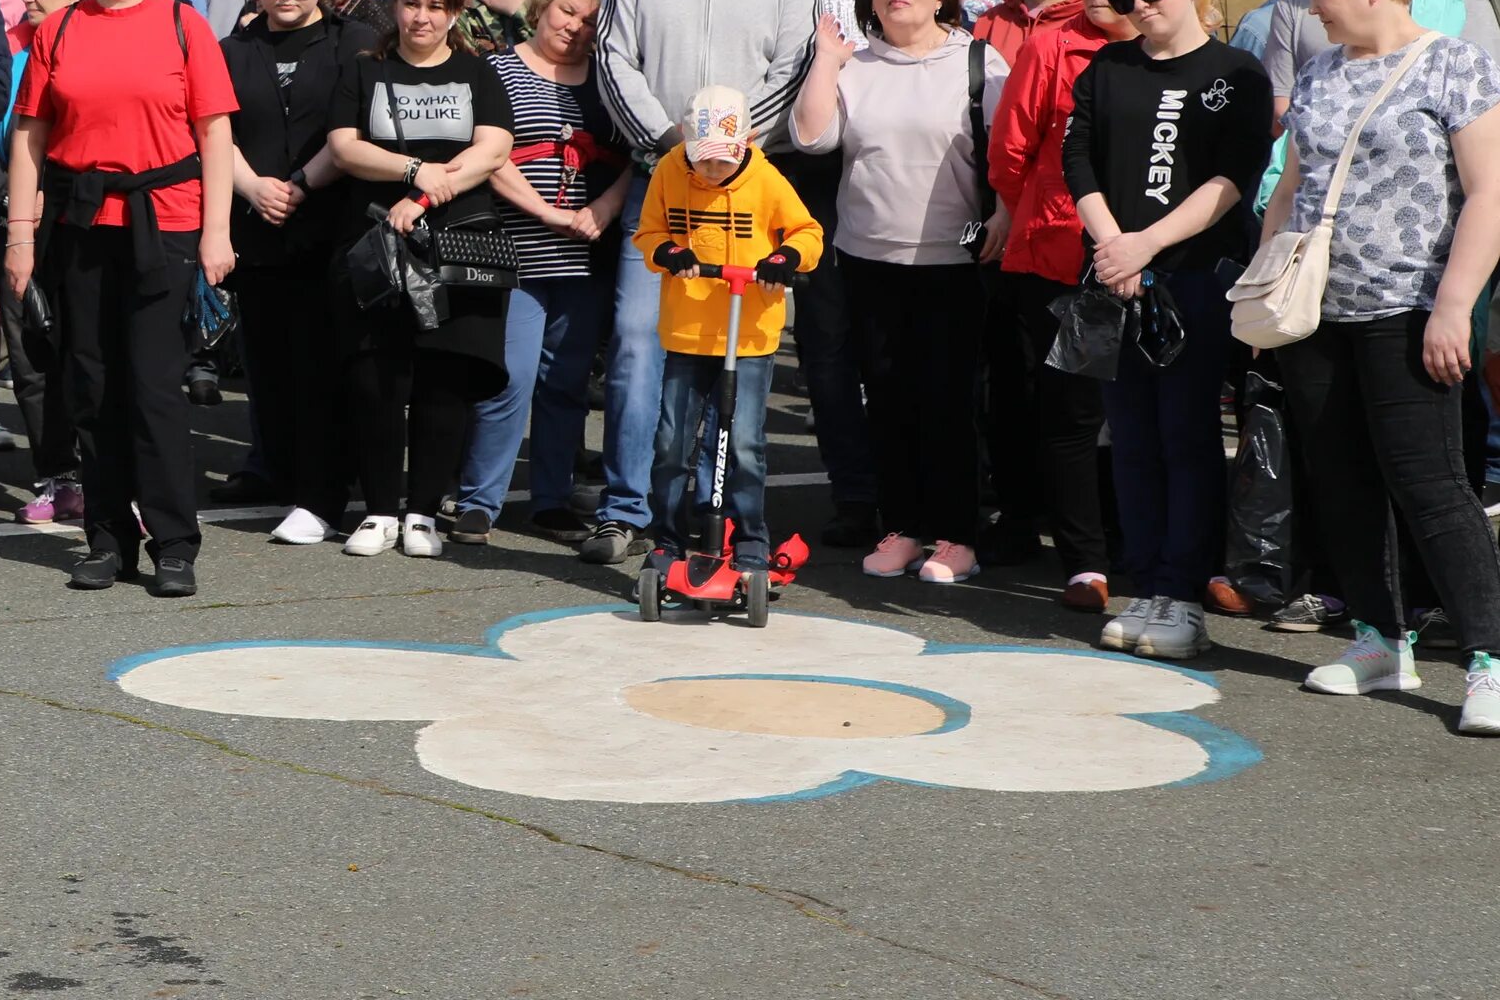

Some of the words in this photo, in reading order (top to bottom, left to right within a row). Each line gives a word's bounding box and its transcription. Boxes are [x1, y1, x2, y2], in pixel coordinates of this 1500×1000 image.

[415, 95, 458, 106] WHAT
[426, 108, 462, 120] LIKE
[1145, 90, 1187, 204] MICKEY
[466, 267, 495, 282] Dior
[714, 428, 728, 494] KREISS
